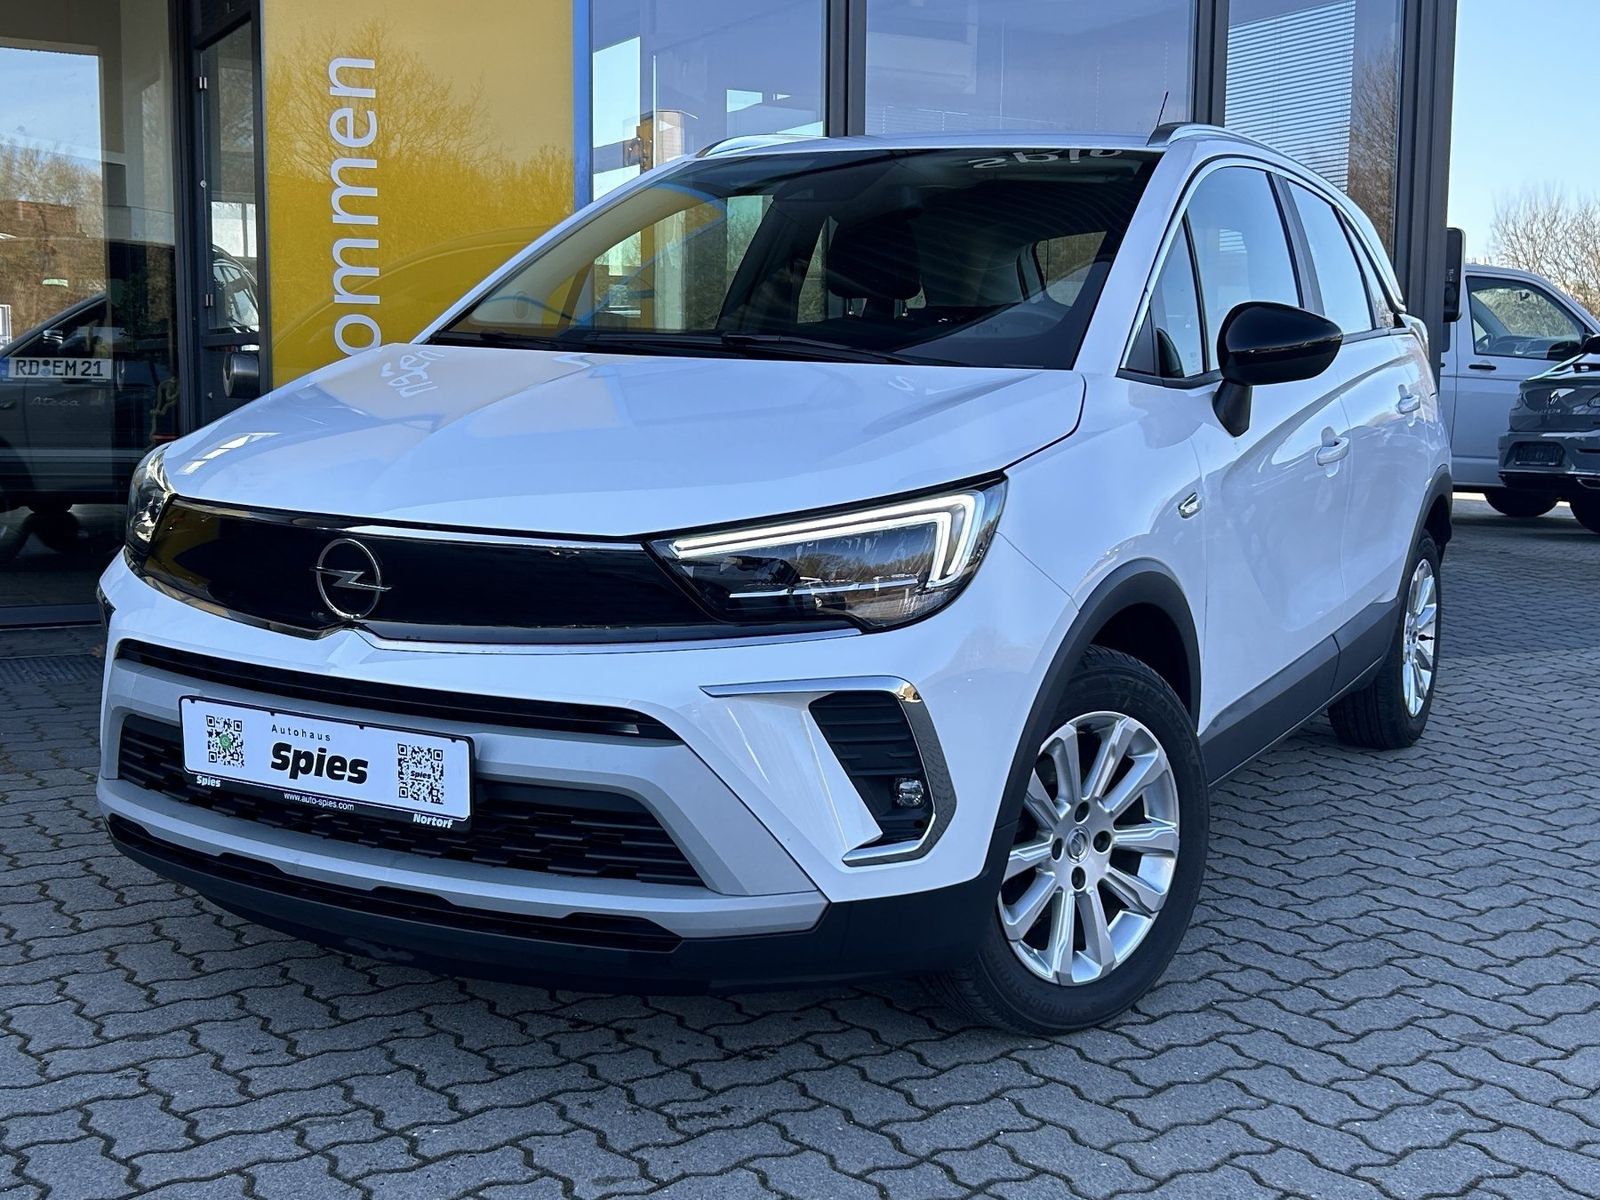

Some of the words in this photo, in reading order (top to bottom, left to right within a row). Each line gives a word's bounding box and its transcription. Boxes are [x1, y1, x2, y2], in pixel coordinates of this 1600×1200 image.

[15, 359, 40, 376] RD
[271, 724, 332, 742] Autohaus
[270, 742, 369, 785] Spies
[196, 775, 221, 788] Spies
[410, 770, 432, 780] Spies
[283, 792, 355, 811] www.auto-spies.com
[412, 813, 454, 829] Nortorf
